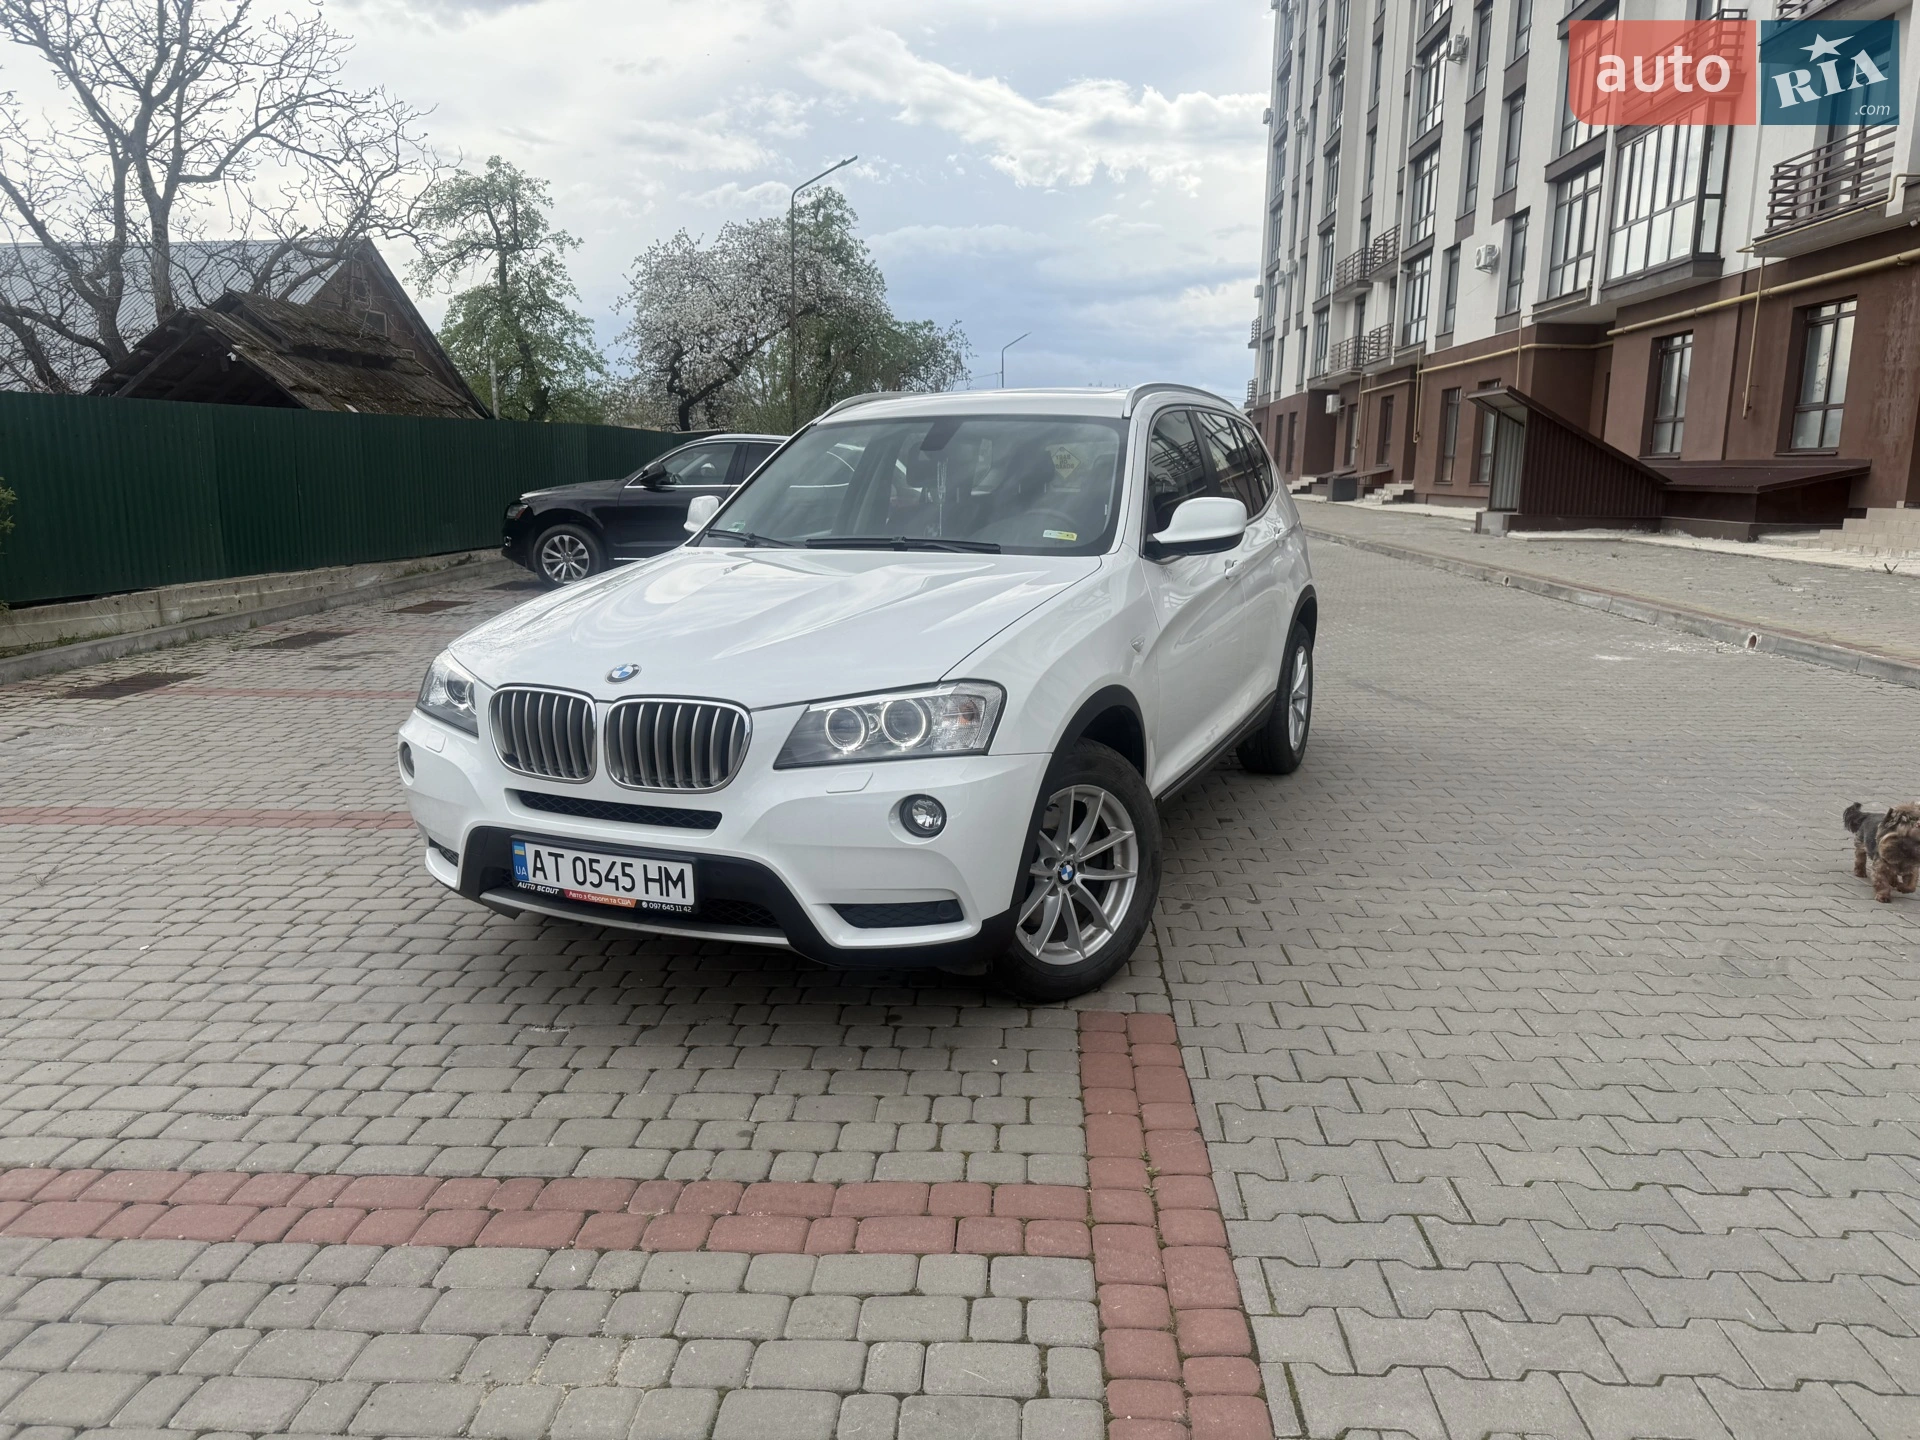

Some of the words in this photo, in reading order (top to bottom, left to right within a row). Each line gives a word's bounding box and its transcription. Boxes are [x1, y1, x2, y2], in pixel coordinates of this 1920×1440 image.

[515, 865, 527, 876] UA
[532, 849, 565, 883] AT
[572, 855, 636, 893] 0545
[643, 864, 687, 899] HM
[517, 881, 536, 891] AUTO
[536, 885, 560, 895] SCOUT
[568, 891, 583, 899] Авто
[617, 898, 632, 906] США
[648, 902, 661, 910] 097
[662, 903, 675, 911] 645
